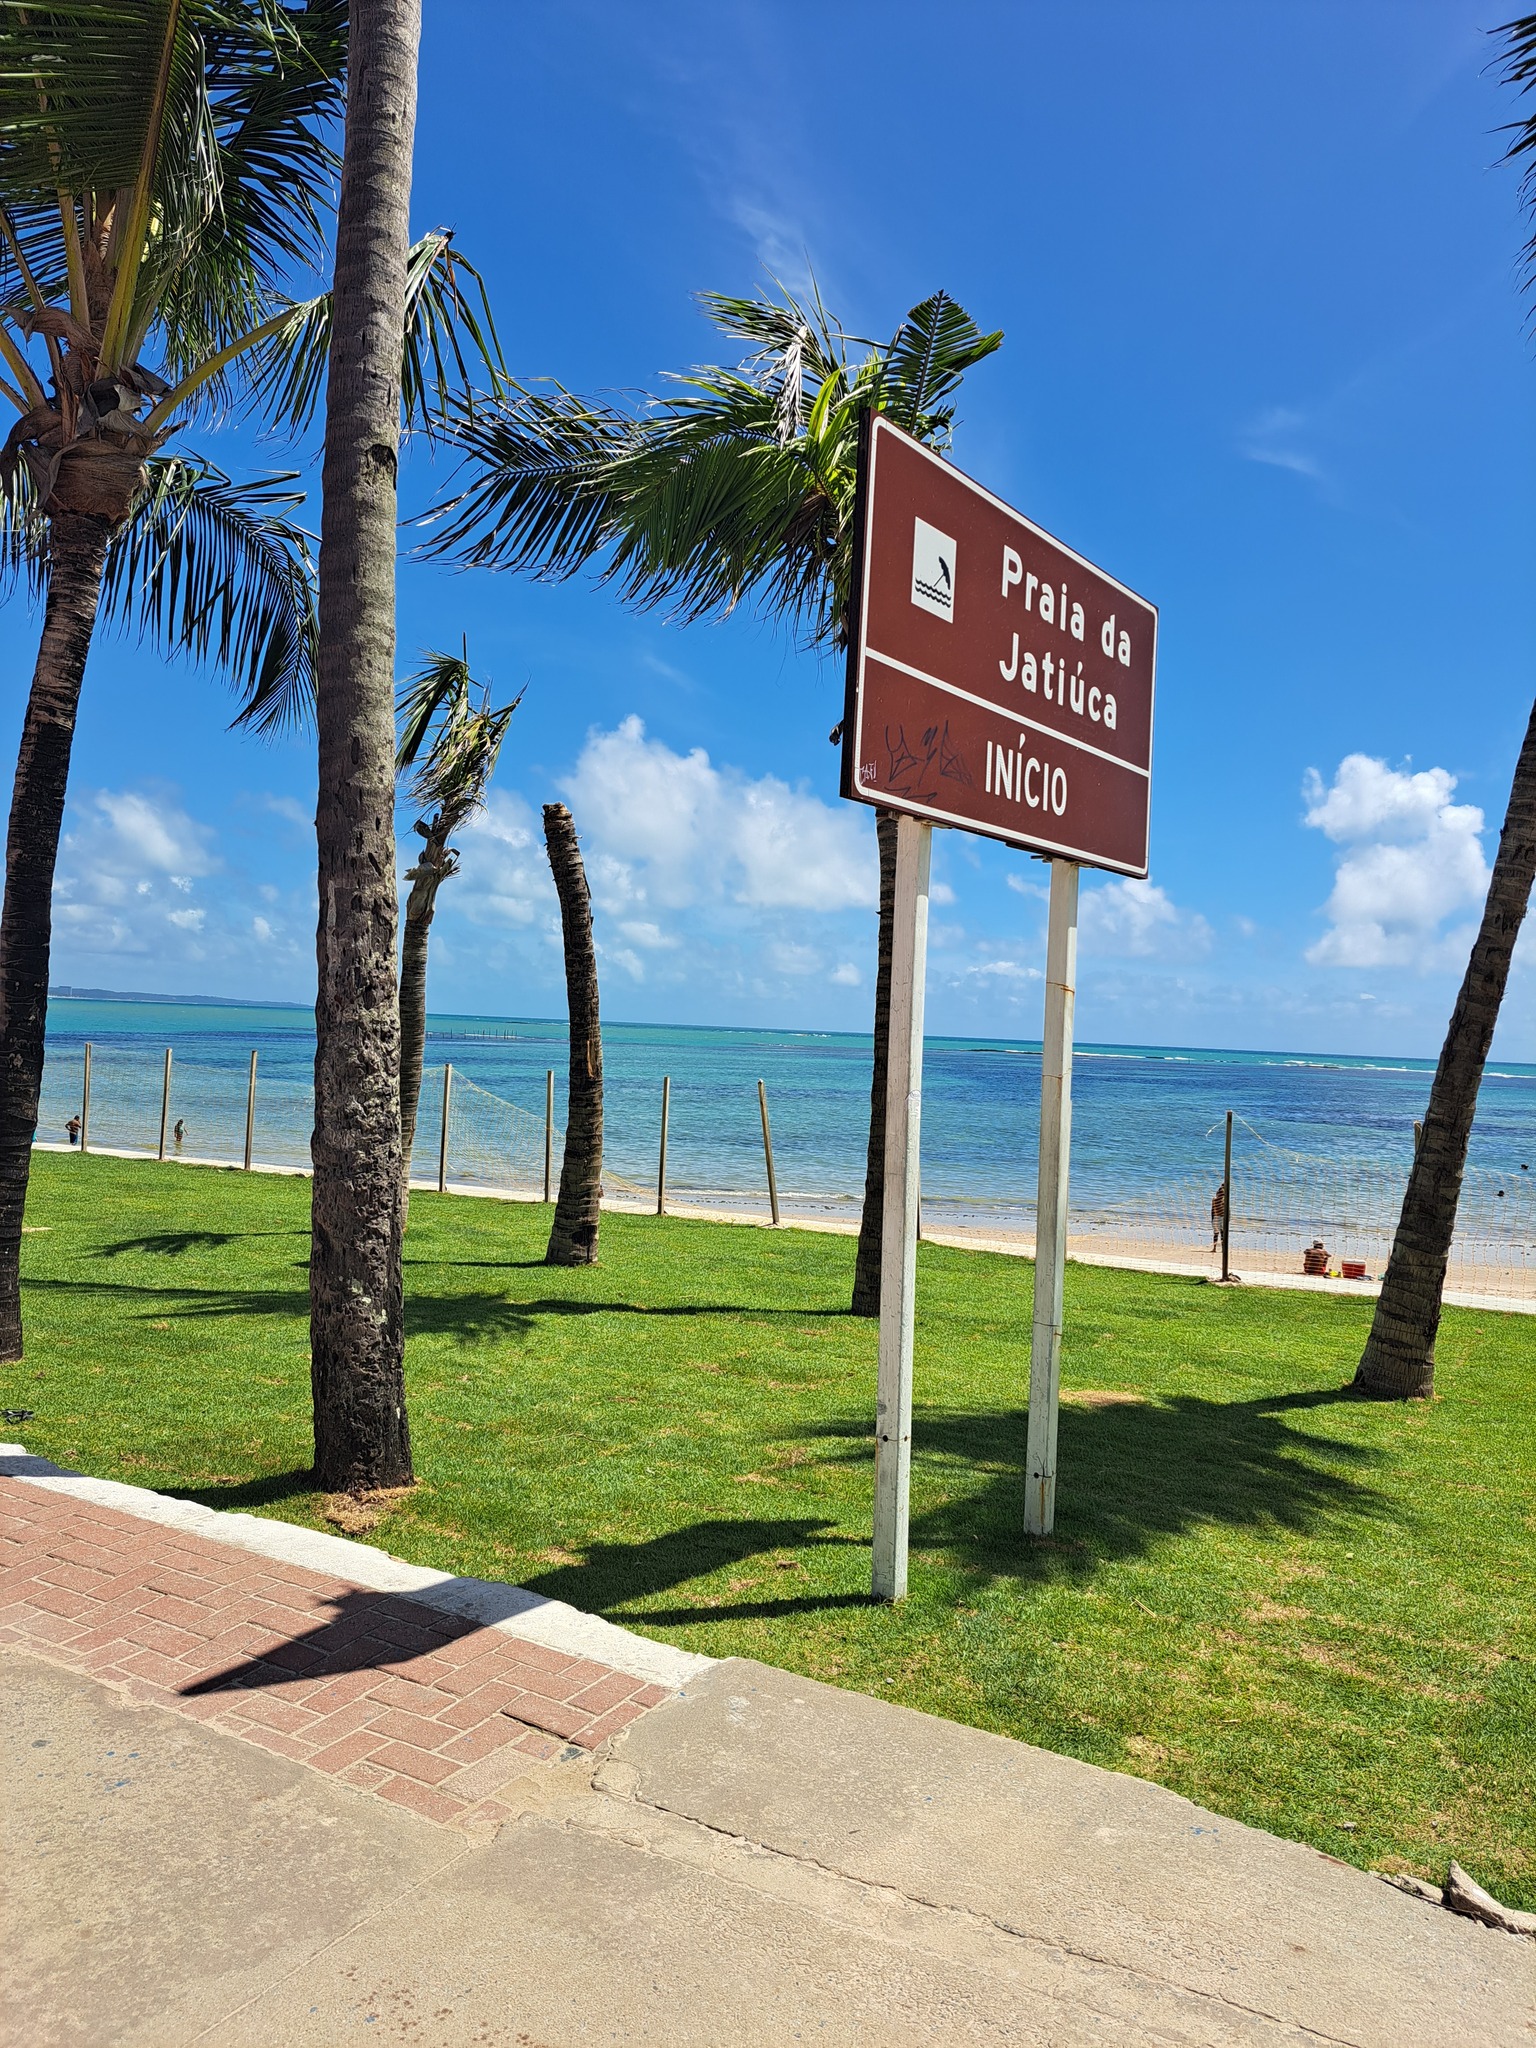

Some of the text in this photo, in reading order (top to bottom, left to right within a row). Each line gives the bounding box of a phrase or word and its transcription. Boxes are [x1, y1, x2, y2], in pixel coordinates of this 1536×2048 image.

[1001, 544, 1131, 668] Praia da
[998, 632, 1117, 731] Jatiúca
[985, 732, 1068, 817] INÍCIO
